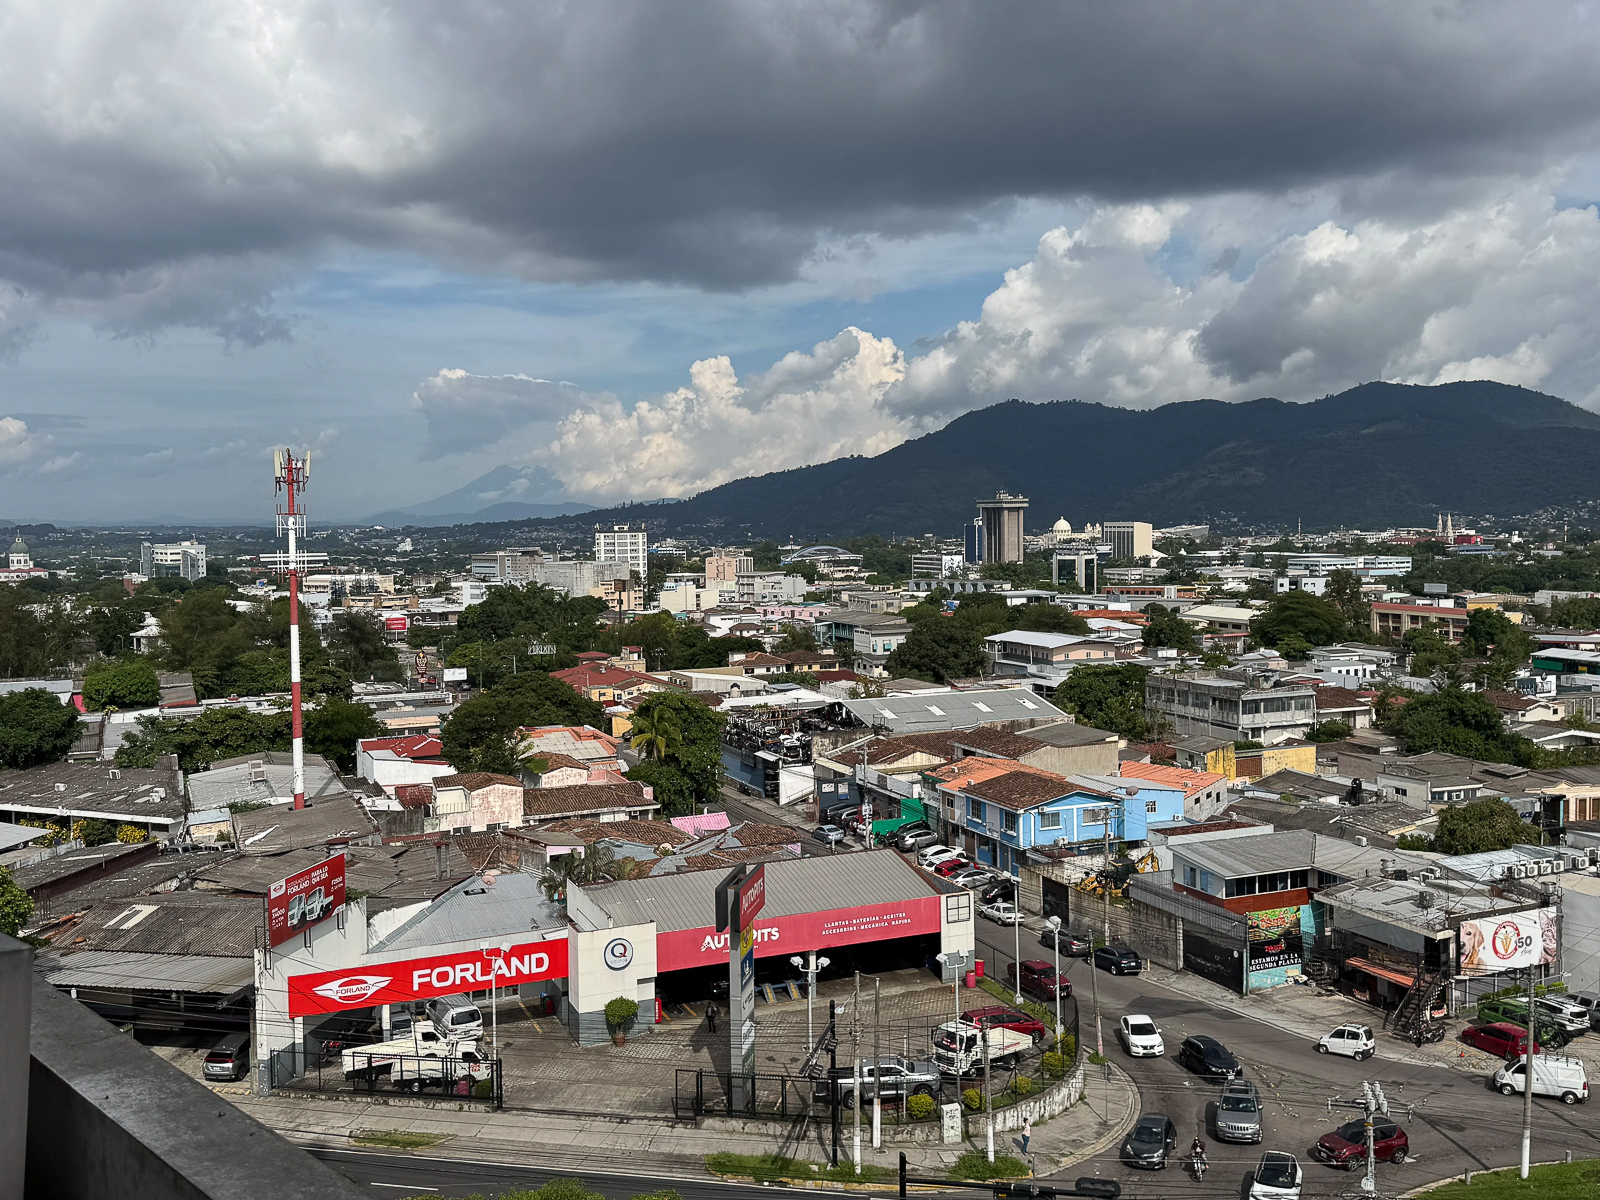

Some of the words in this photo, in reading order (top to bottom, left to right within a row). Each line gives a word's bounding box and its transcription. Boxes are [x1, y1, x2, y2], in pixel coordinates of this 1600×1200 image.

[287, 880, 310, 896] FORLAND
[824, 919, 849, 928] LLANTAS
[883, 912, 907, 920] ACEITES
[822, 926, 857, 935] ACCESORIOS
[1517, 935, 1533, 949] 50
[610, 942, 628, 958] Q
[1249, 961, 1277, 971] SEGUNDA
[1278, 957, 1302, 967] PLANTA
[1251, 955, 1279, 965] ESTAMOS
[1280, 953, 1289, 961] EN
[412, 952, 550, 992] FORLAND
[335, 985, 371, 995] FORLAND
